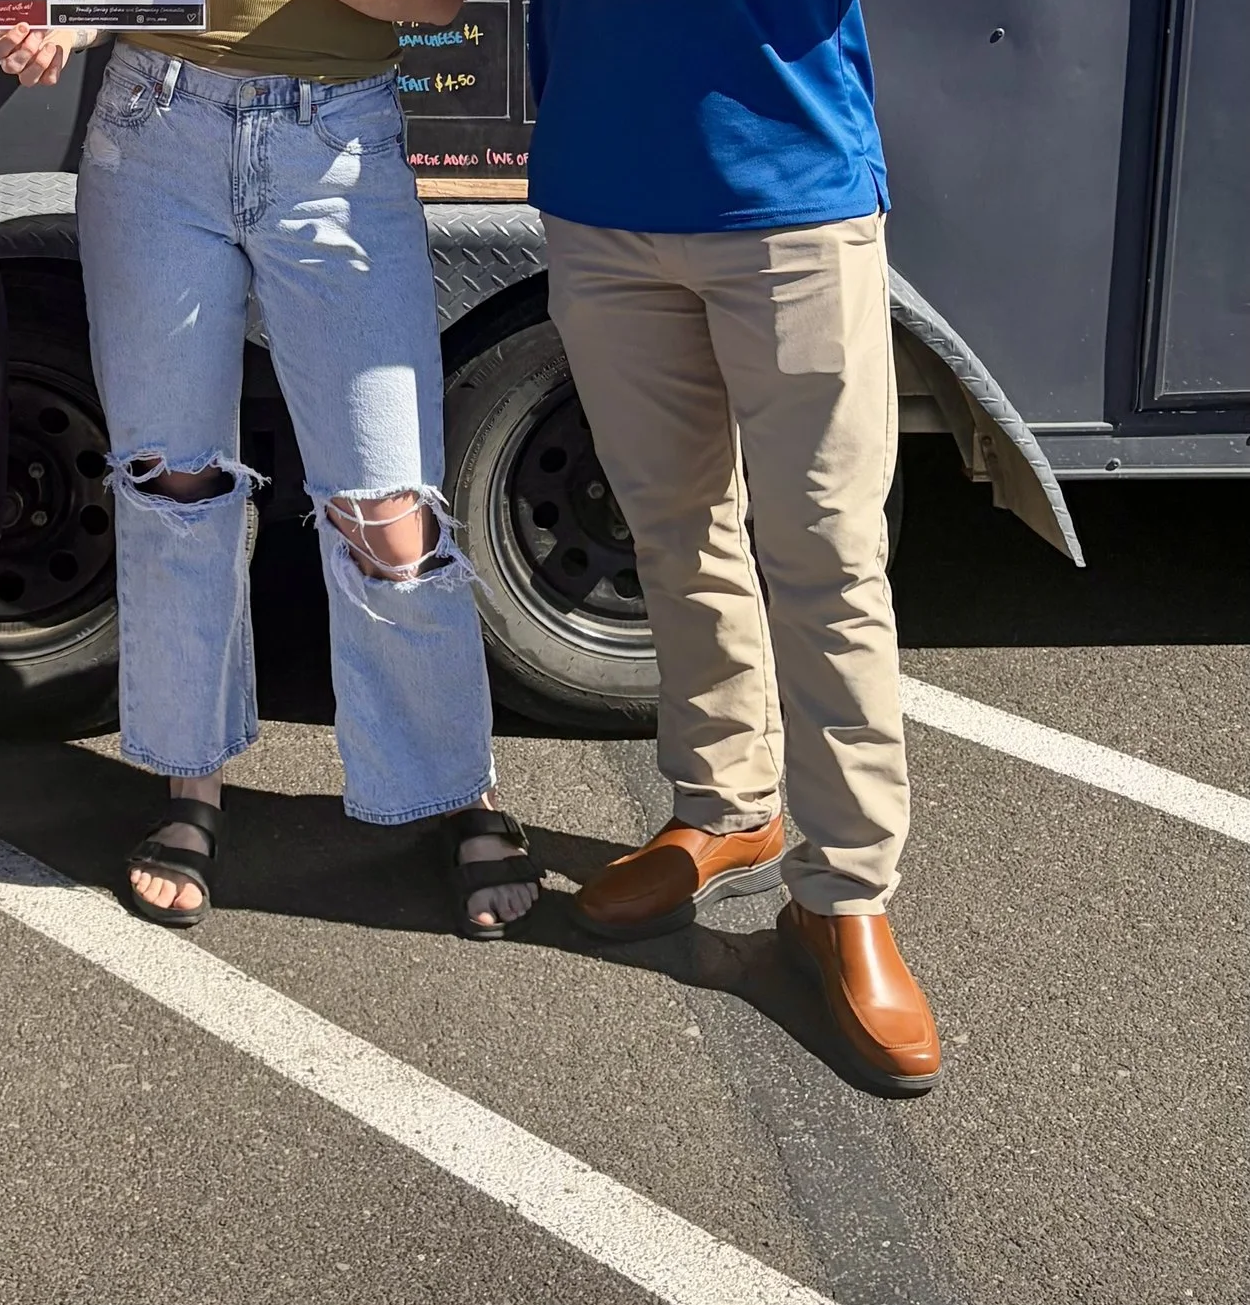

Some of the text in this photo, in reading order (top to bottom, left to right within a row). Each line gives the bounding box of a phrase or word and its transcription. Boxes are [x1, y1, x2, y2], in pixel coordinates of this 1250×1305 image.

[398, 24, 484, 47] EAM CHEESE $4
[398, 73, 476, 92] FAIT $4.50
[407, 154, 440, 166] ARGE
